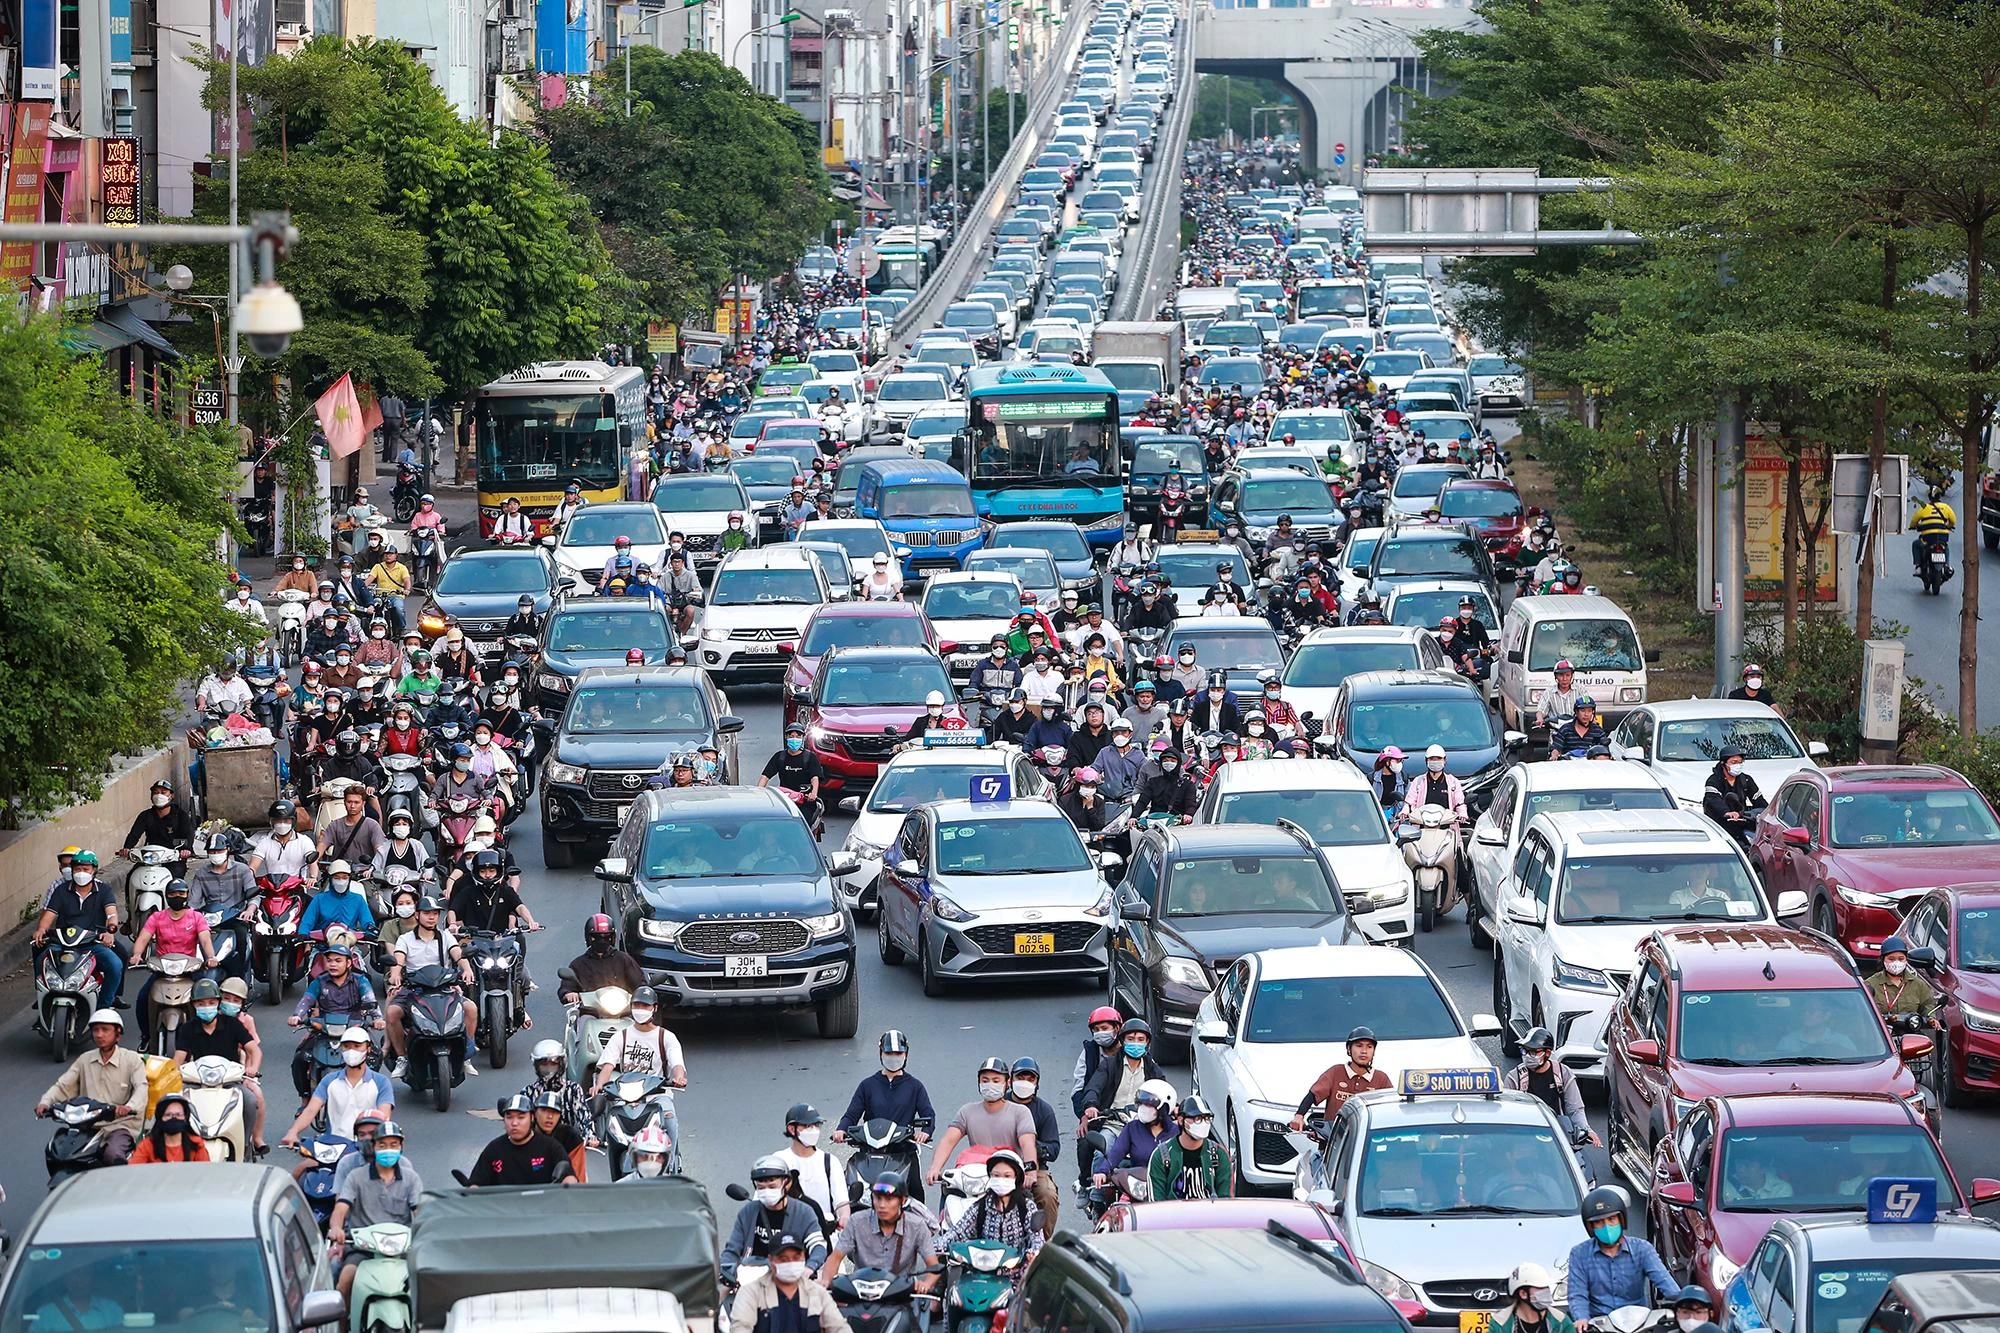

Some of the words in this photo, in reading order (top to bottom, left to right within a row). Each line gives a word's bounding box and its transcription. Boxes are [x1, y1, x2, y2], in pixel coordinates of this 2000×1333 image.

[197, 392, 219, 406] 636
[194, 410, 222, 424] 630A
[527, 465, 537, 476] 16
[946, 722, 960, 730] 56
[980, 777, 1001, 799] G7
[698, 911, 790, 919] EVEREST
[1026, 935, 1043, 944] 29E
[1019, 944, 1050, 953] 002.96
[737, 957, 756, 966] 30H
[730, 966, 763, 976] 722.16
[1430, 1075, 1451, 1091] SAO
[1475, 1073, 1490, 1090] ĐÔ
[1886, 1184, 1921, 1219] G7
[1882, 1211, 1902, 1219] TAXI
[1825, 1287, 1838, 1295] 92
